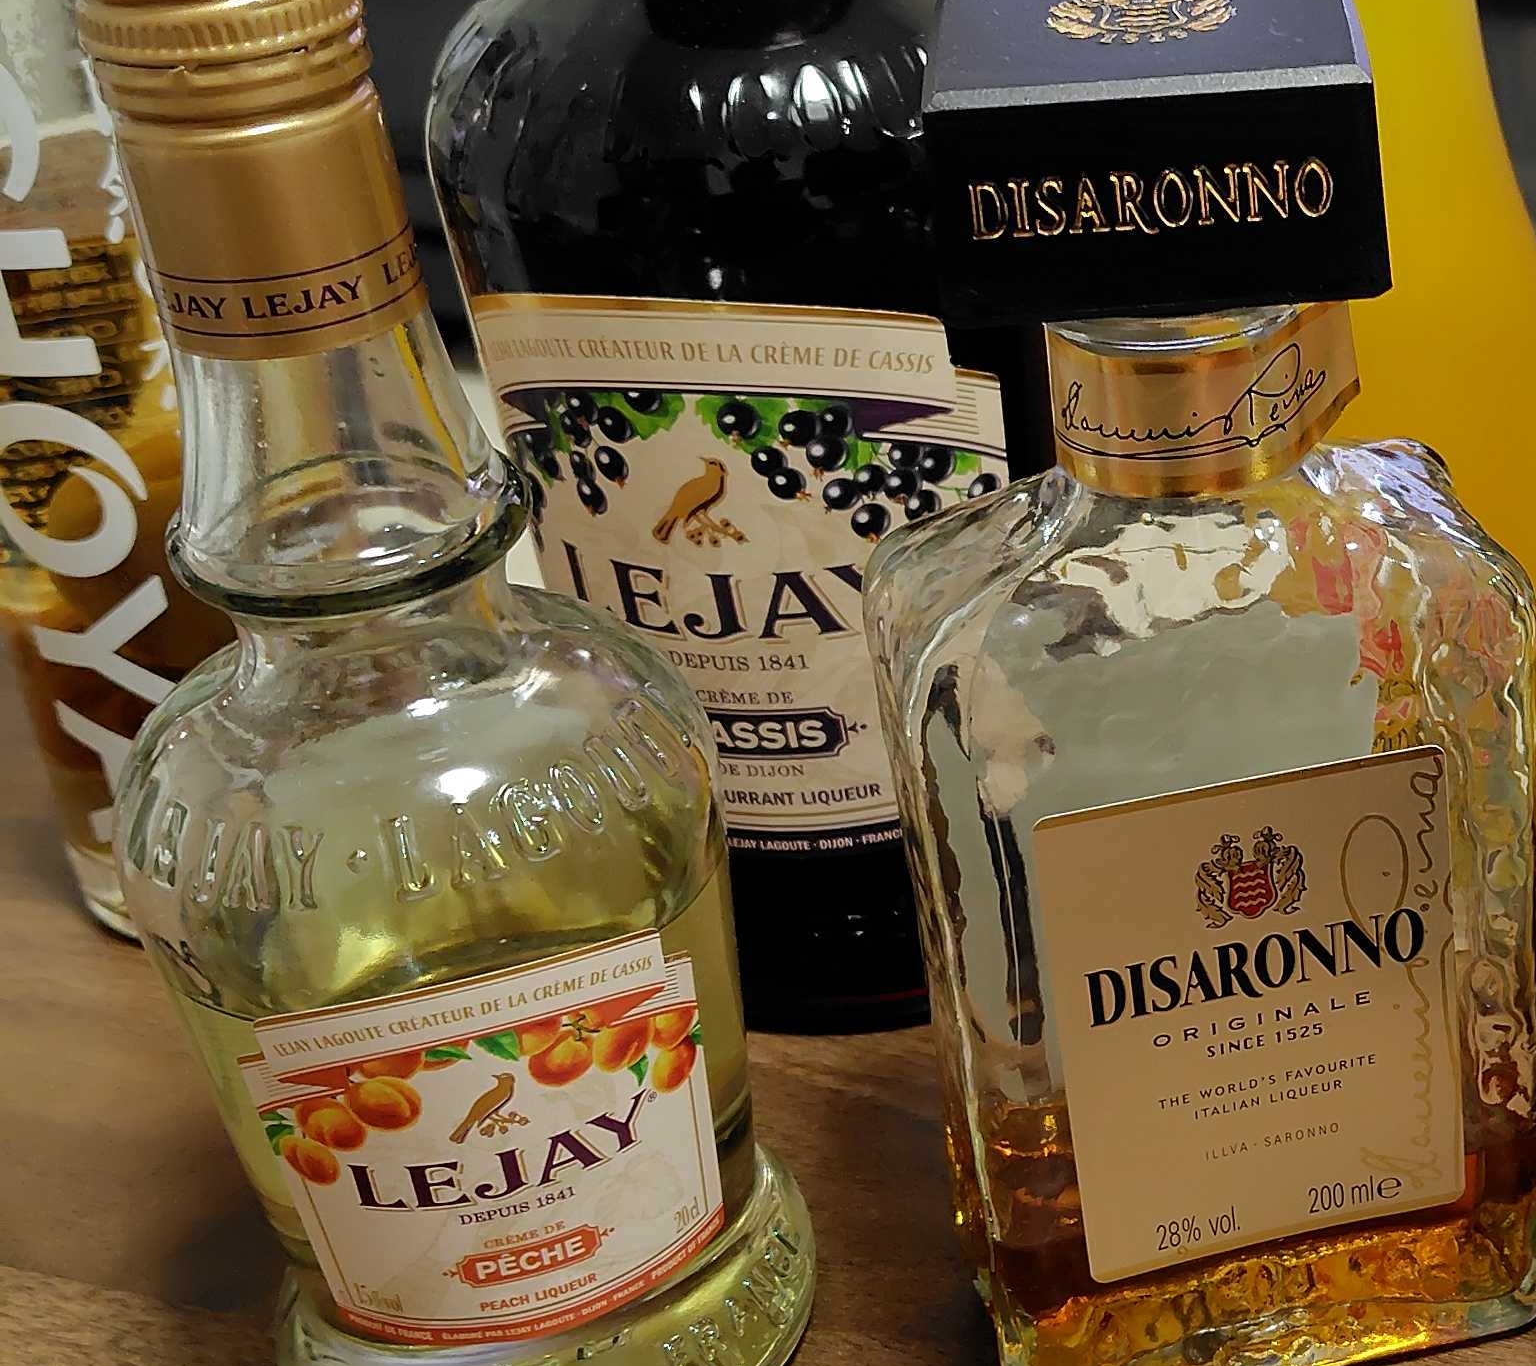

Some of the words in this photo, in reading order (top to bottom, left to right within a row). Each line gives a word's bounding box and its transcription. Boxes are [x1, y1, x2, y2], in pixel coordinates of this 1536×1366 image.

[969, 156, 1333, 240] DISARONNO
[241, 274, 363, 320] LEJAY
[578, 335, 674, 361] CRÉATEUR
[682, 342, 708, 363] DE
[713, 343, 743, 364] LA
[752, 341, 825, 366] CRÈME
[833, 348, 862, 368] DE
[869, 350, 936, 373] CASSIS
[668, 649, 750, 672] DEPUIS
[758, 653, 810, 672] 1841
[768, 690, 794, 705] DE
[710, 719, 828, 749] ASSIS
[747, 764, 805, 778] DIJON
[801, 783, 883, 806] LIQUEUR
[819, 837, 854, 850] DIJON
[862, 830, 904, 845] FRANC
[1084, 907, 1426, 1028] DISARONNO
[315, 1025, 384, 1053] LAGOUTE
[388, 1006, 475, 1036] CRÉATEUR
[480, 1001, 501, 1018] DE
[507, 993, 528, 1009] LA
[532, 974, 585, 1003] CRÈME
[589, 971, 608, 987] DE
[611, 955, 654, 981] CASSIS
[1153, 990, 1372, 1048] ORIGINALE
[1206, 1034, 1266, 1058] SINCE
[1275, 1022, 1324, 1044] 1525
[1158, 1092, 1191, 1111] THE
[1199, 1073, 1277, 1099] WORLD'S
[1285, 1053, 1378, 1081] FAVOURITE
[1193, 1096, 1260, 1121] ITALIAN
[1270, 1079, 1344, 1105] LIQUEUR
[346, 1088, 650, 1211] LEJAY
[1204, 1141, 1249, 1162] ILLVA
[1263, 1122, 1340, 1148] SARONNO
[460, 1202, 530, 1226] DEPUIS
[536, 1186, 576, 1208] 1841
[1307, 1182, 1345, 1214] 200
[543, 1221, 565, 1235] DE
[1155, 1215, 1201, 1251] 28%
[1208, 1206, 1241, 1237] vol.
[475, 1235, 587, 1281] PÊCHE
[480, 1294, 530, 1313] PEACH
[535, 1274, 597, 1304] LIQUEUR
